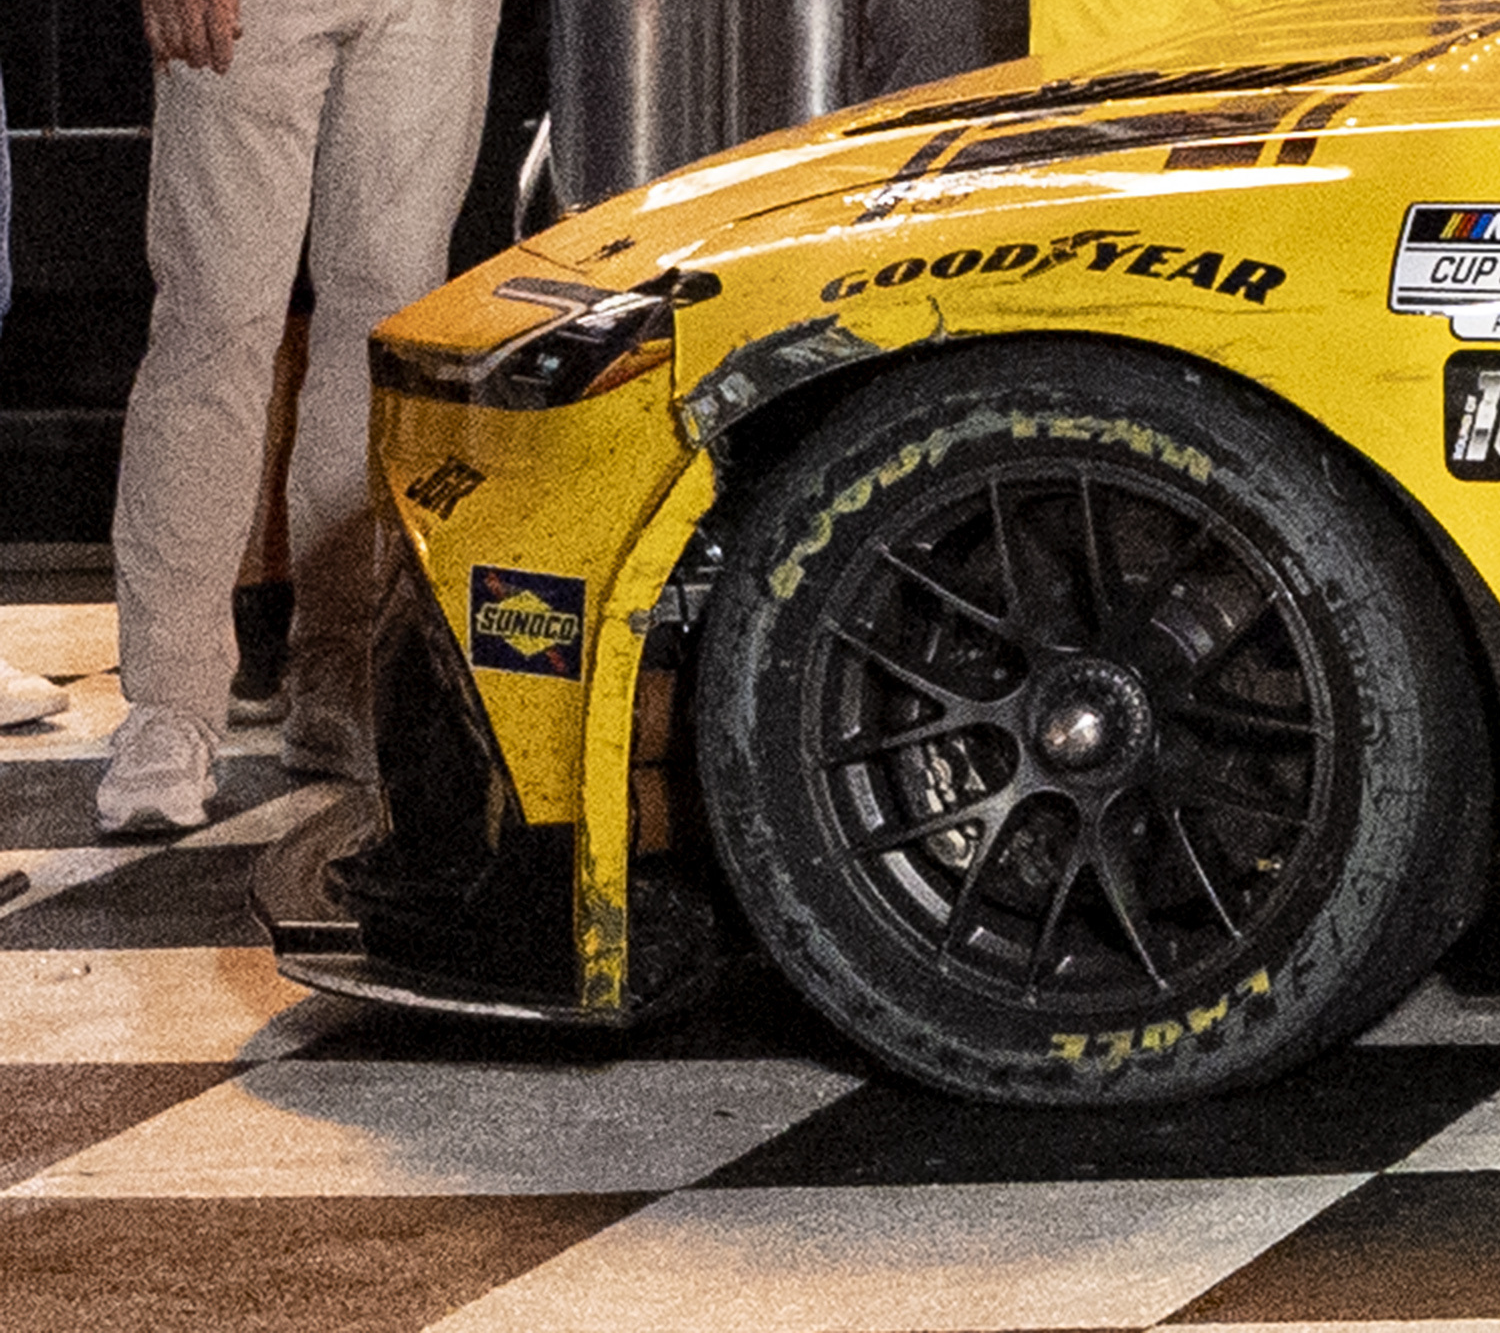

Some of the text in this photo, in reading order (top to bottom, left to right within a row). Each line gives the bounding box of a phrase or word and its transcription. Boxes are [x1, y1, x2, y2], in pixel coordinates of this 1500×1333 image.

[820, 229, 1288, 305] GOODYEAR
[1430, 256, 1498, 285] CUP
[477, 607, 579, 643] SUNOCO
